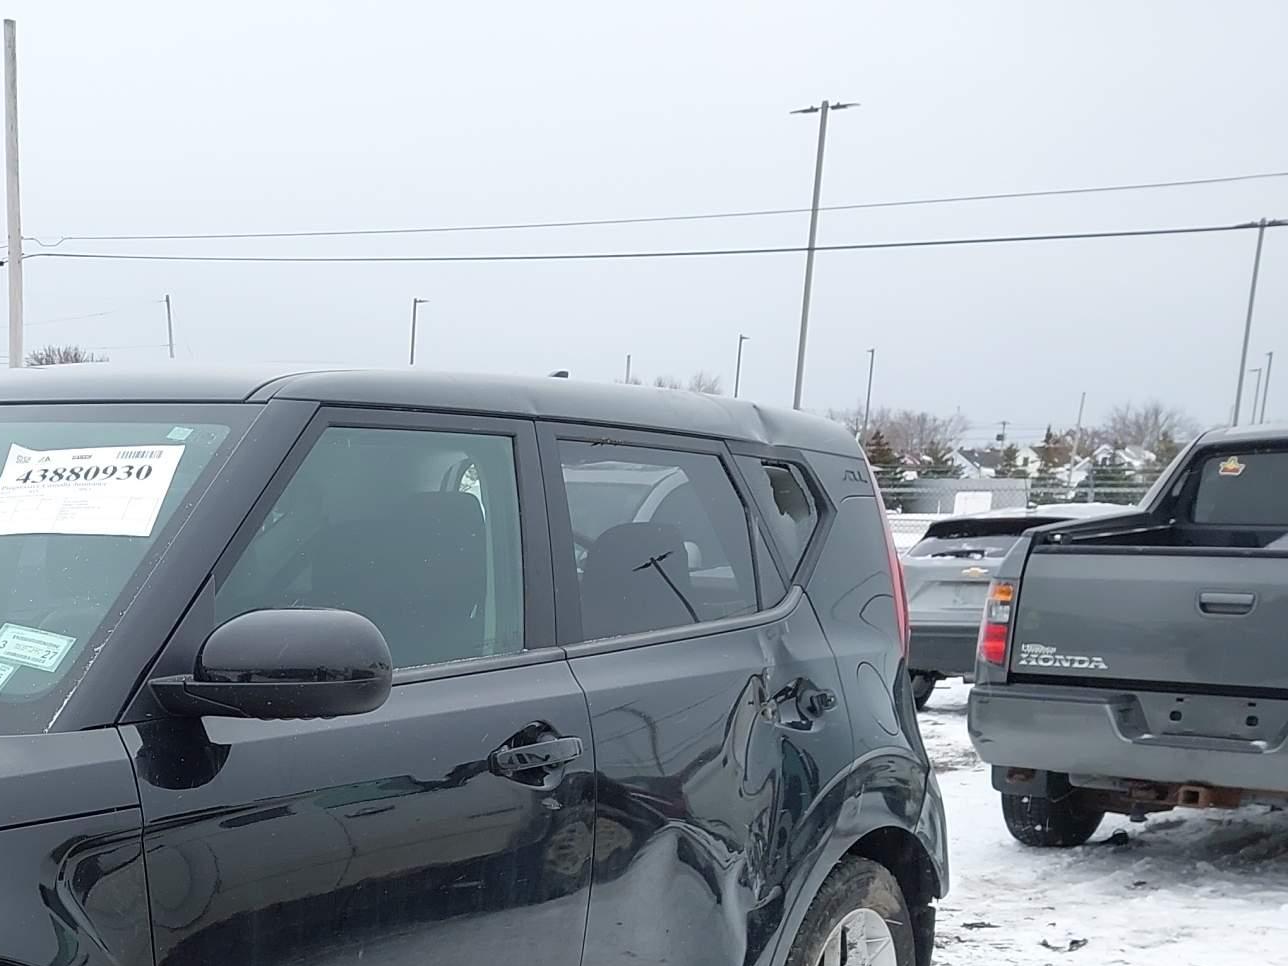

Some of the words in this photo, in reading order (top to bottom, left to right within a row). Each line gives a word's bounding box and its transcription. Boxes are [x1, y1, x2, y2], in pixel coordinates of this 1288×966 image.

[15, 464, 153, 483] 43880930
[41, 650, 58, 660] 27
[1018, 653, 1108, 669] HONDA
